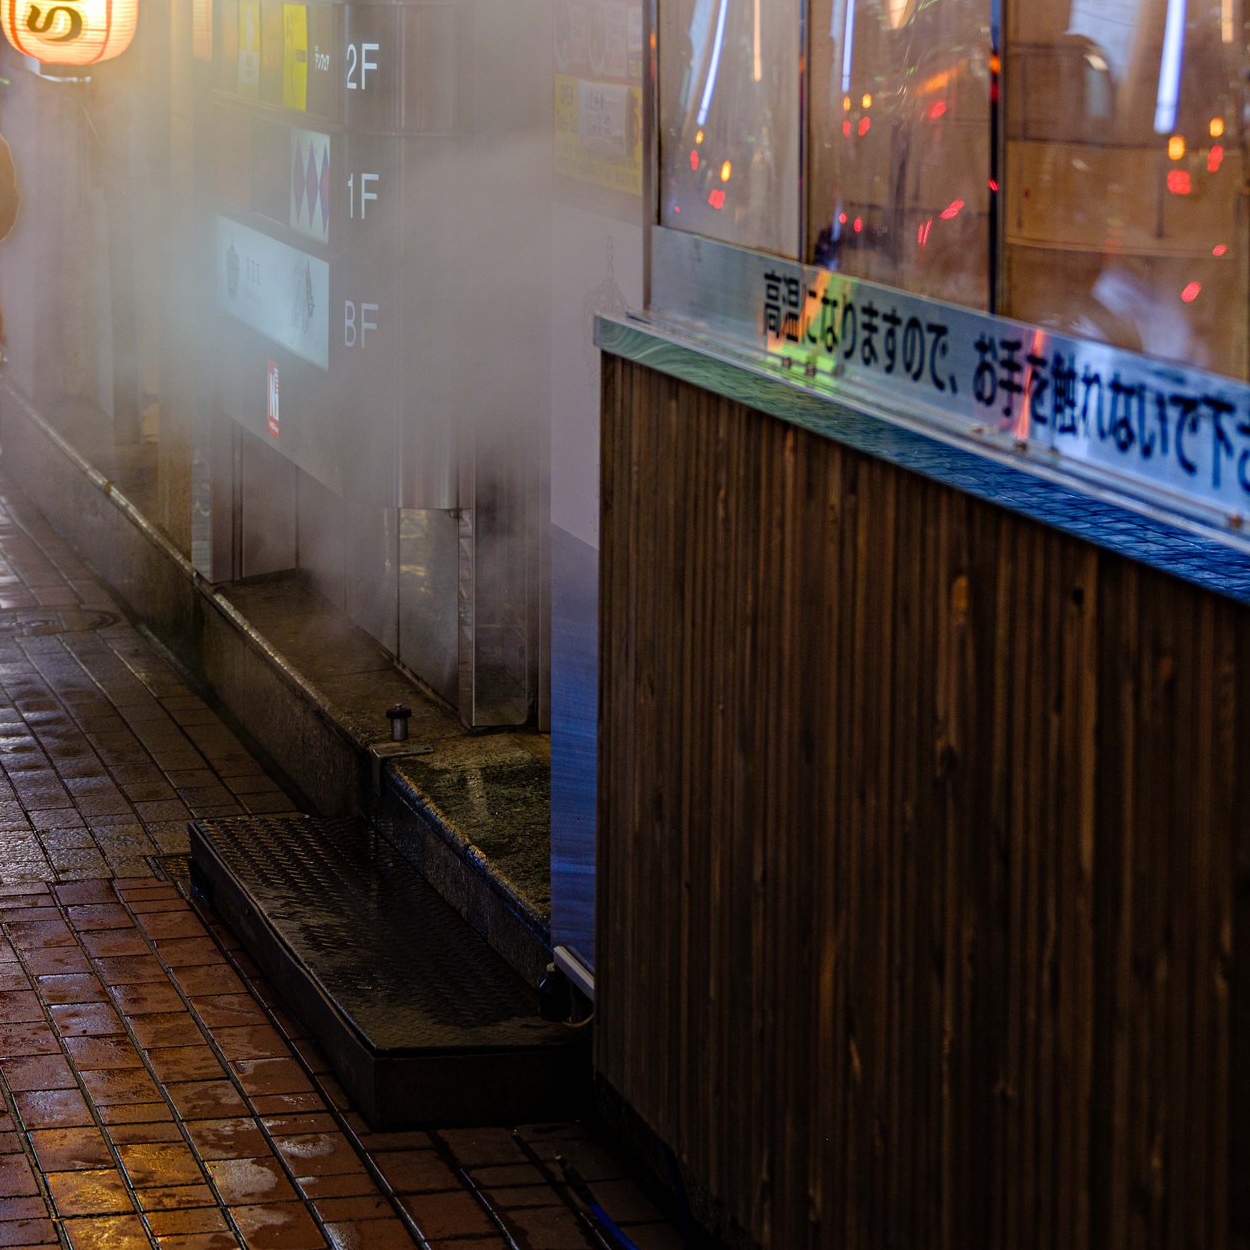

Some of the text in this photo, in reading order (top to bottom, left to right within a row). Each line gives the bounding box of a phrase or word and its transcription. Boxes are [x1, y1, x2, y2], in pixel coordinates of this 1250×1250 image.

[346, 42, 379, 90] 2F
[347, 172, 380, 220] 1F
[344, 300, 380, 349] BF
